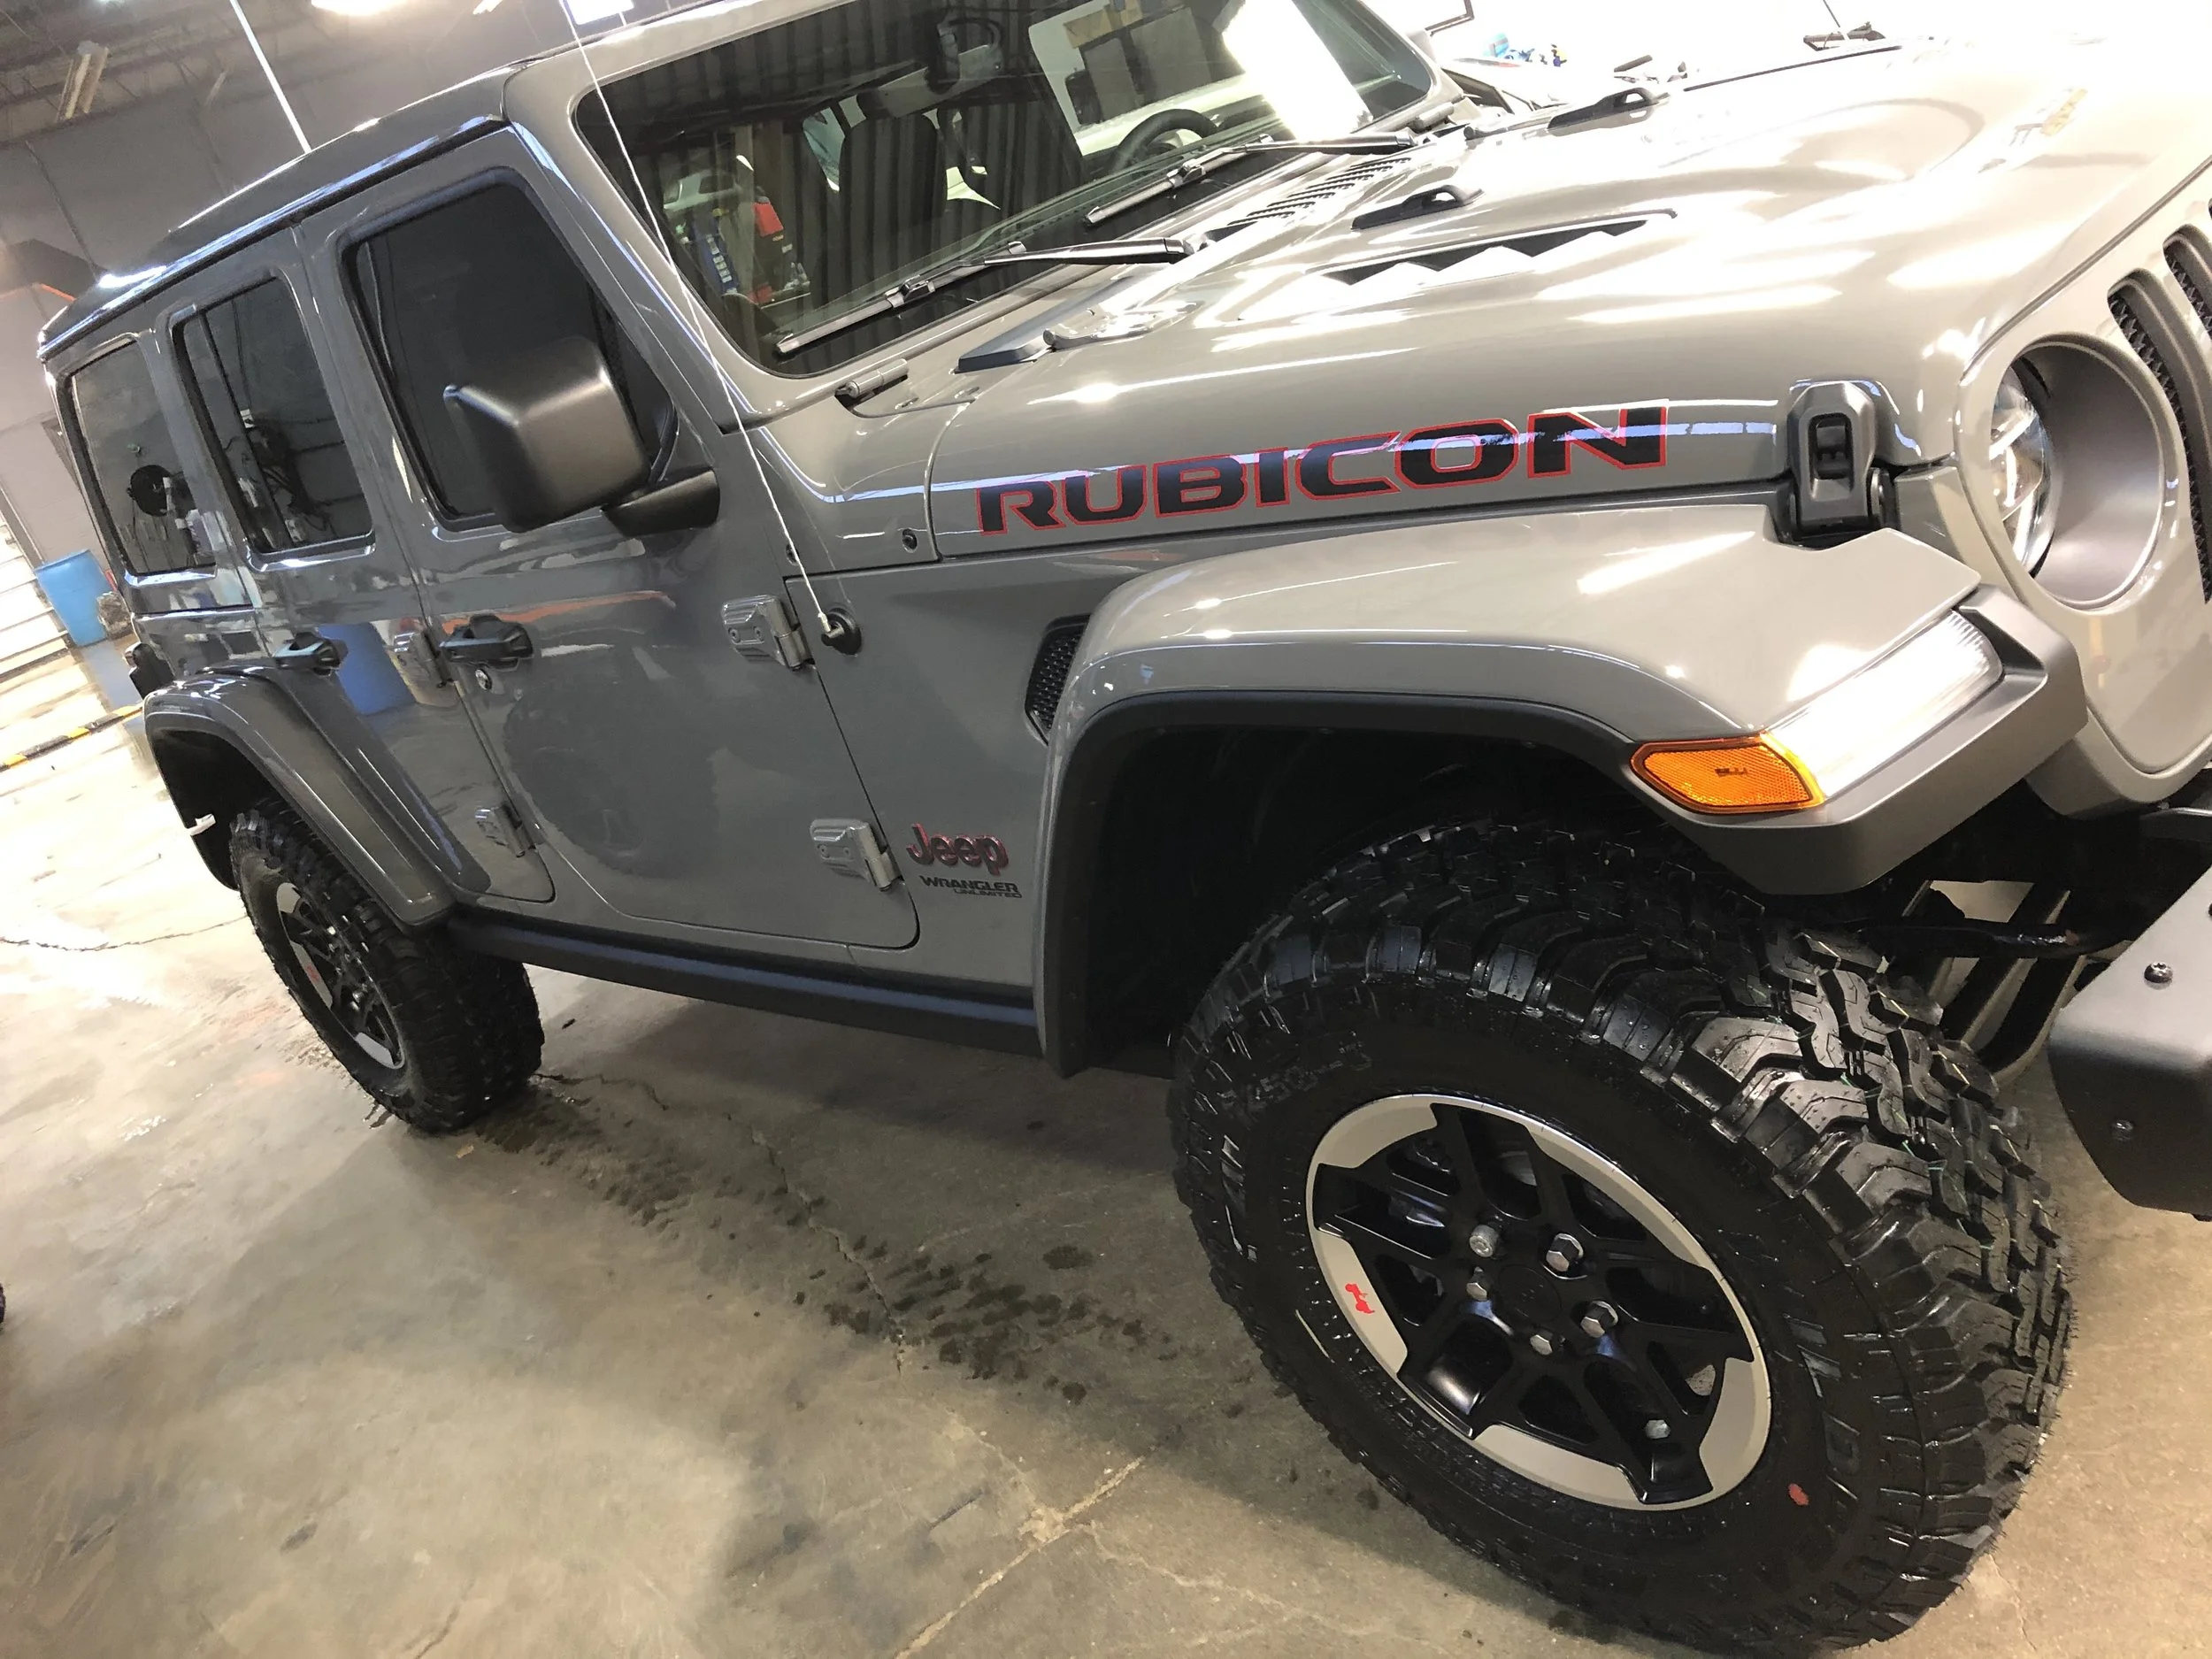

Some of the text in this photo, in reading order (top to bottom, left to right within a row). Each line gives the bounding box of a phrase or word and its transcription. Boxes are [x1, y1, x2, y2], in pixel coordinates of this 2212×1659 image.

[976, 403, 1669, 534] RUBICON
[906, 823, 1009, 876] Jeep
[919, 875, 1018, 893] WRANGLER
[953, 888, 1022, 898] UNLIMITED
